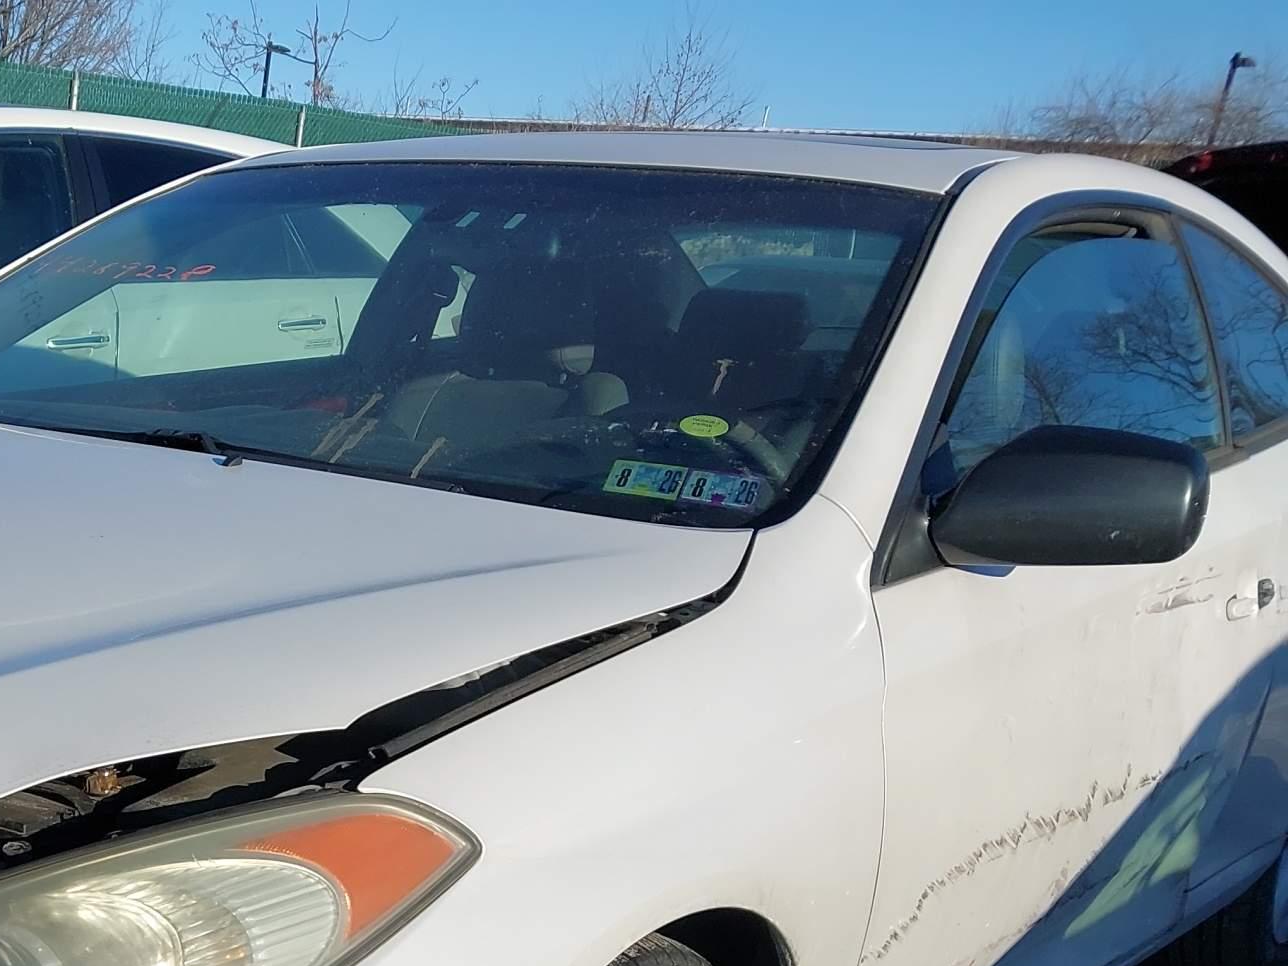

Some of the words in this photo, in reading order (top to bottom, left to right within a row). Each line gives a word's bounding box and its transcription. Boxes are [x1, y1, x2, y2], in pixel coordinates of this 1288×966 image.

[616, 468, 631, 488] 8
[658, 470, 683, 495] 26
[691, 477, 707, 498] 8
[734, 480, 759, 505] 26
